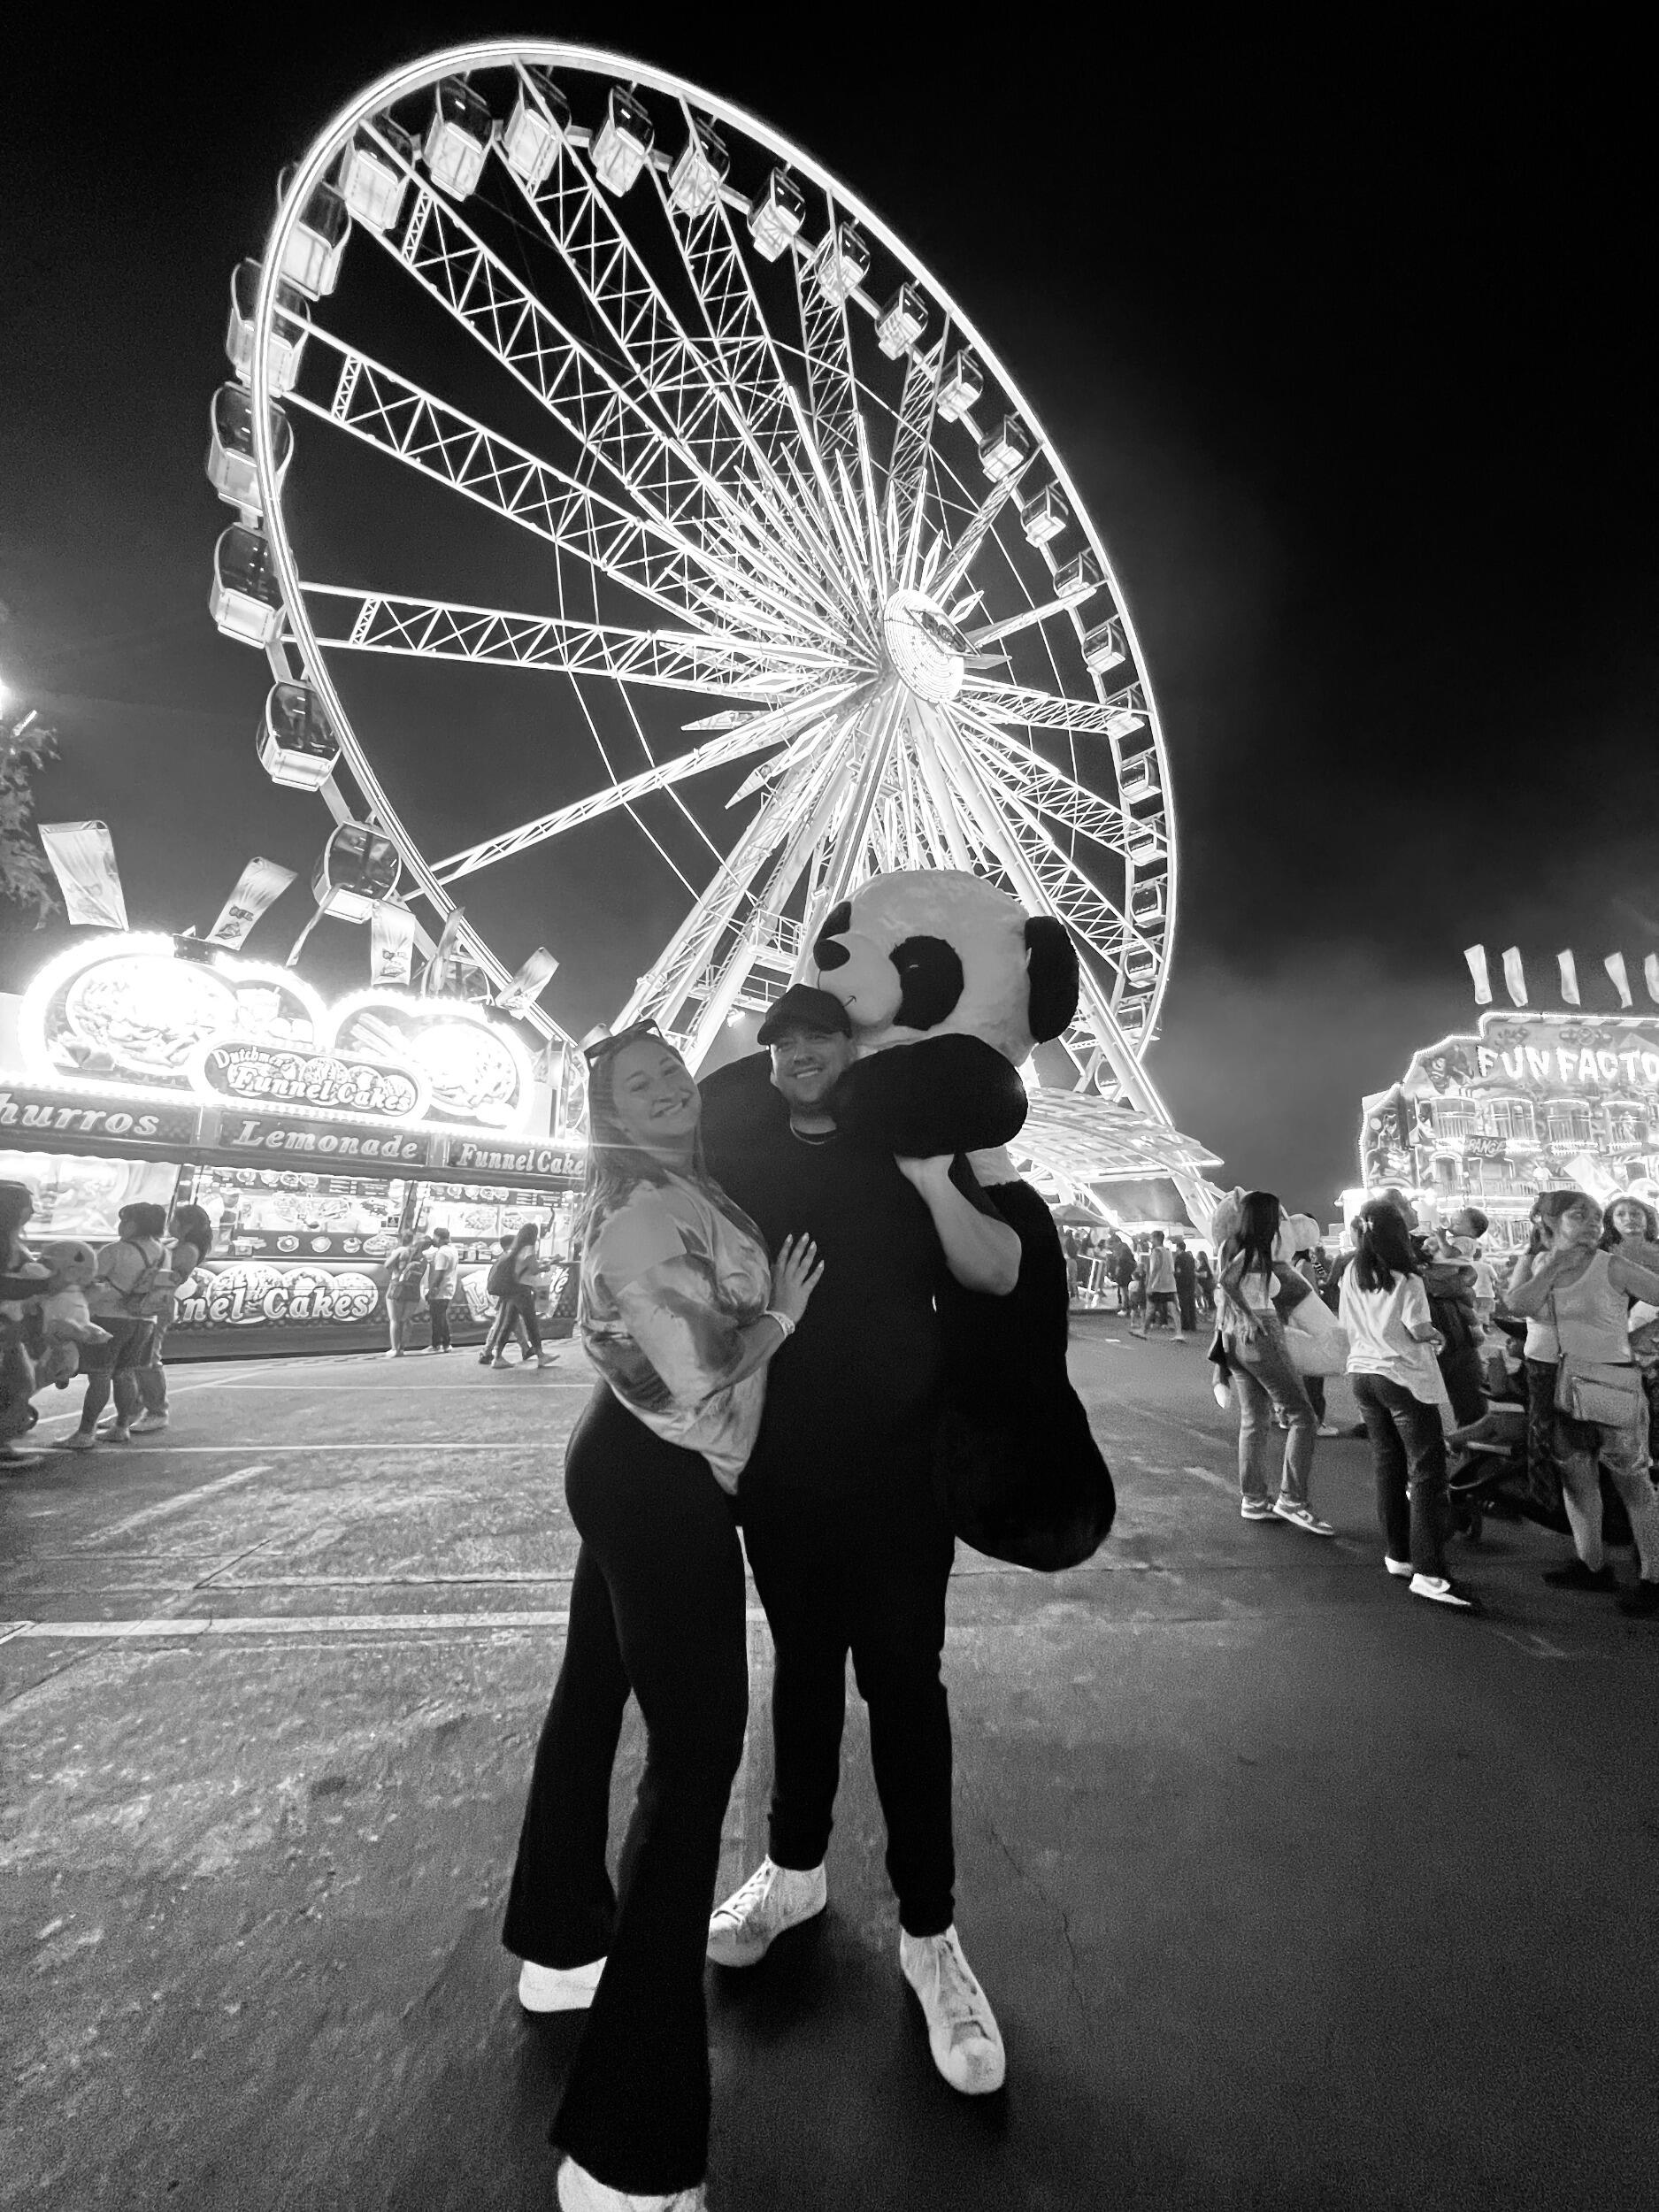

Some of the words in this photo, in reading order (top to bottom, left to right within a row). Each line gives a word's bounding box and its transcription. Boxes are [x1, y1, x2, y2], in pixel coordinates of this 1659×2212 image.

[1476, 1045, 1549, 1080] FUN
[1555, 1047, 1659, 1084] FACTO
[228, 1065, 334, 1101] Funnel
[336, 1081, 412, 1111] Cakes
[0, 1092, 160, 1135] hurros
[232, 1119, 419, 1159] Lemonade
[456, 1142, 536, 1172] Funnel
[174, 1286, 246, 1322] nel
[263, 1285, 370, 1319] Cakes
